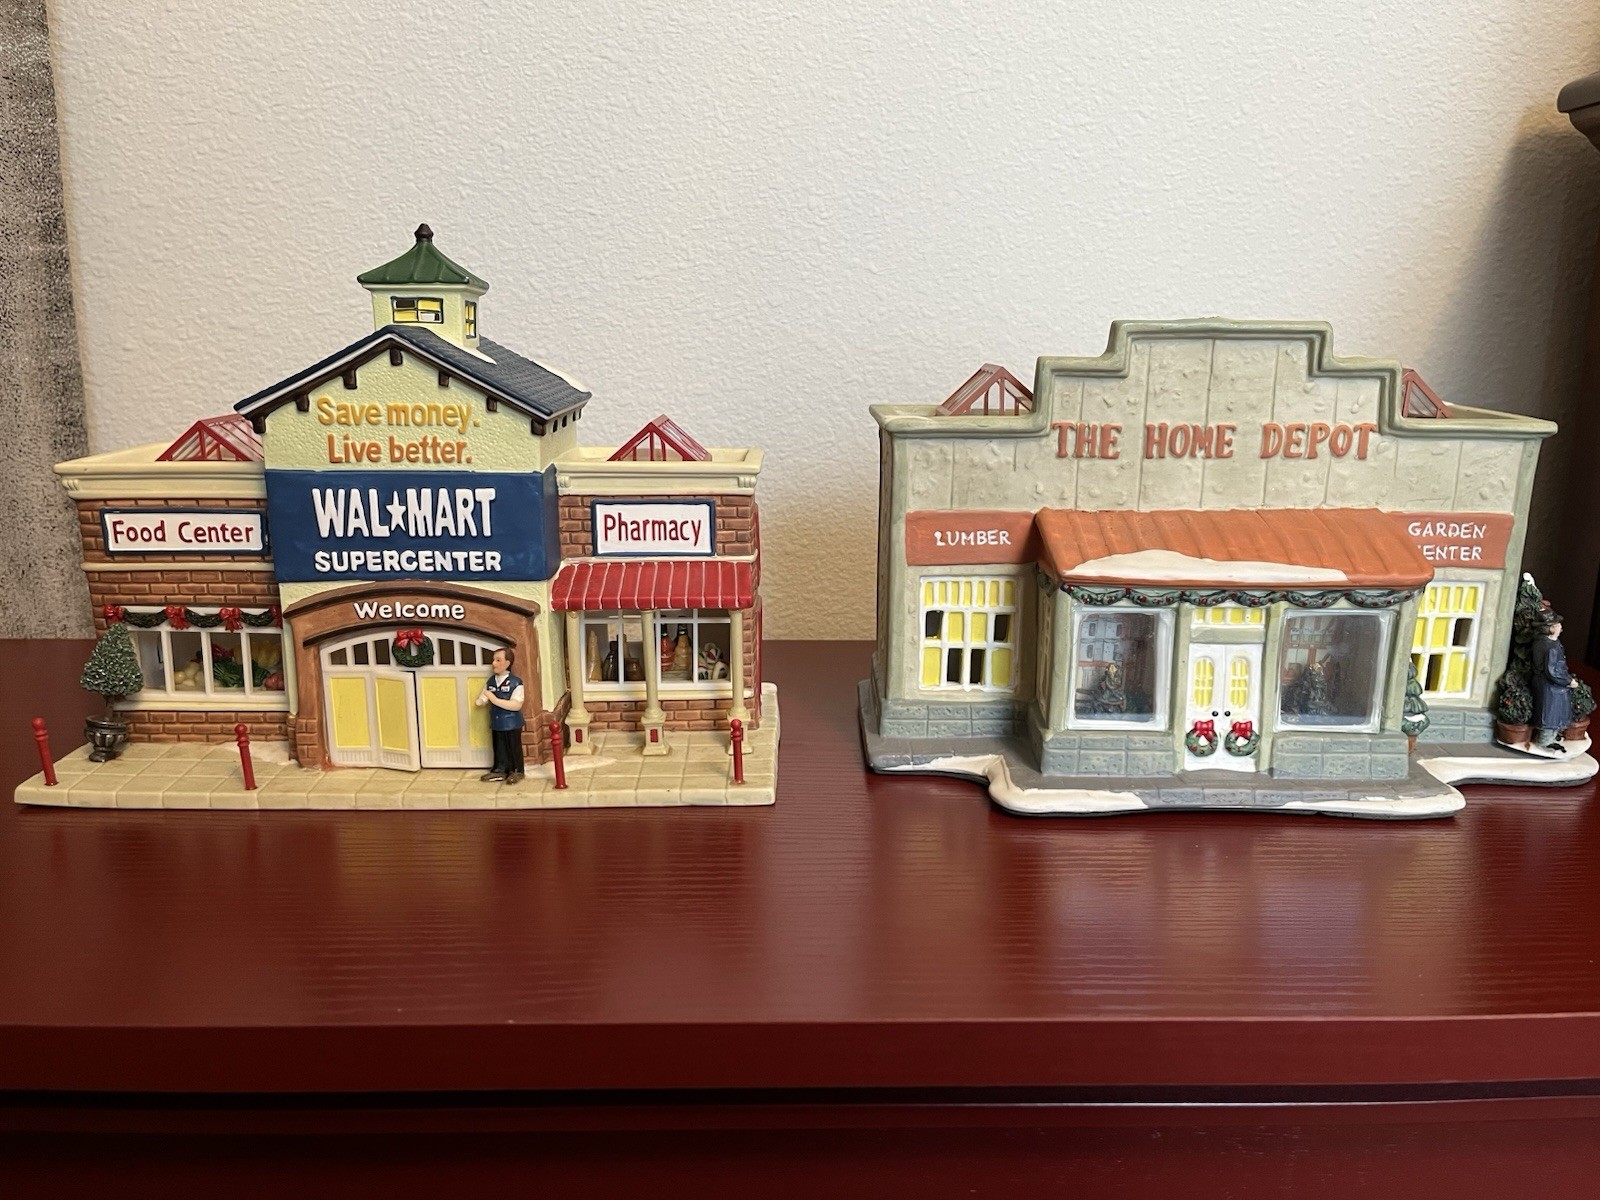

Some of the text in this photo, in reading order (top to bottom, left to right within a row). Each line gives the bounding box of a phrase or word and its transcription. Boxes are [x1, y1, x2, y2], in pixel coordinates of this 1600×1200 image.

[318, 396, 480, 432] Save money.
[327, 434, 473, 463] Live better.
[1052, 422, 1377, 460] THE HOME DEPOT
[112, 520, 254, 543] Food Center
[603, 512, 702, 546] Pharmacy
[934, 530, 1011, 546] LUMBER
[1408, 522, 1486, 539] GARDEN
[314, 550, 502, 572] SUPERCENTER
[1417, 544, 1482, 561] ENTER
[354, 602, 465, 620] Welcome
